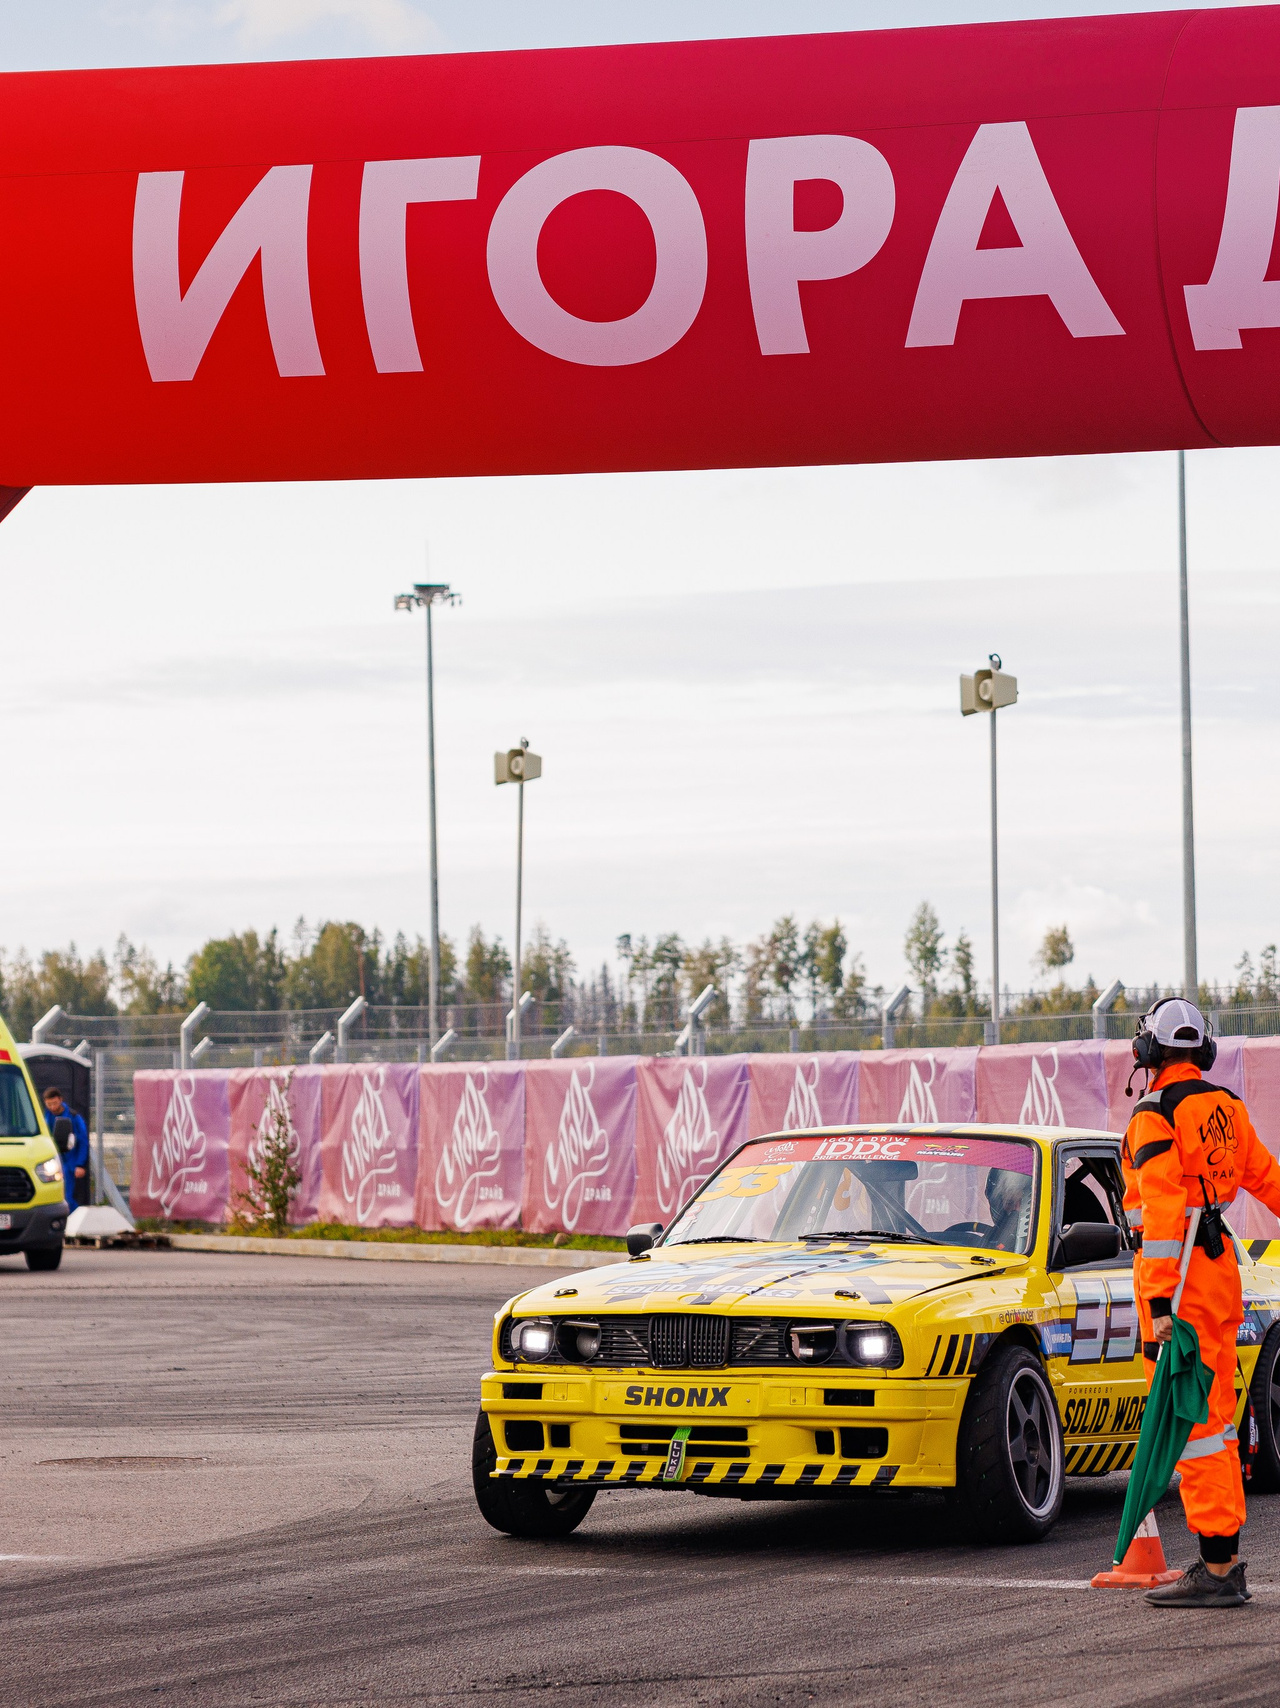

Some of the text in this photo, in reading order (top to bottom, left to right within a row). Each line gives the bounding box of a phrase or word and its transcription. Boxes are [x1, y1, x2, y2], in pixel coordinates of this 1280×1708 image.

[132, 120, 1127, 383] ИГОРА
[813, 1141, 908, 1156] IDDC
[695, 1164, 795, 1202] 33
[607, 1283, 799, 1298] SOLID WORKS
[624, 1385, 732, 1407] SHONX
[1063, 1398, 1110, 1434] SOLID
